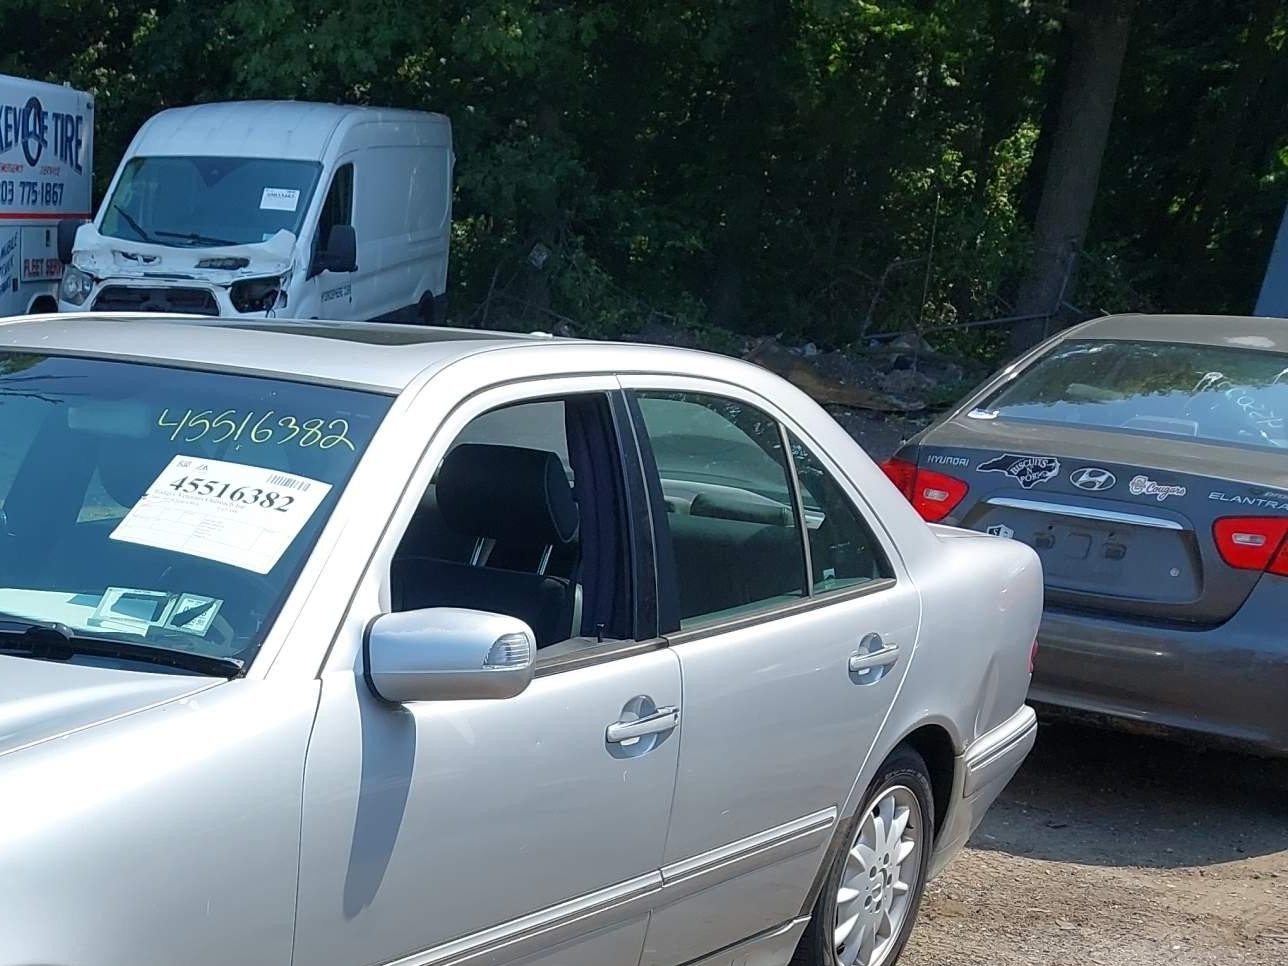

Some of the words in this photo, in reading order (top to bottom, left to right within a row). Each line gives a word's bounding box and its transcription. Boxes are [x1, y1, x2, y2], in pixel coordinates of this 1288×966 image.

[52, 111, 83, 176] TIRE
[158, 408, 356, 452] 45516382
[927, 454, 971, 467] HYUNDAI
[1010, 457, 1049, 476] BISCUITS
[169, 474, 295, 514] 45516382
[1146, 481, 1187, 501] Cougars
[1208, 491, 1288, 512] ELANTRA
